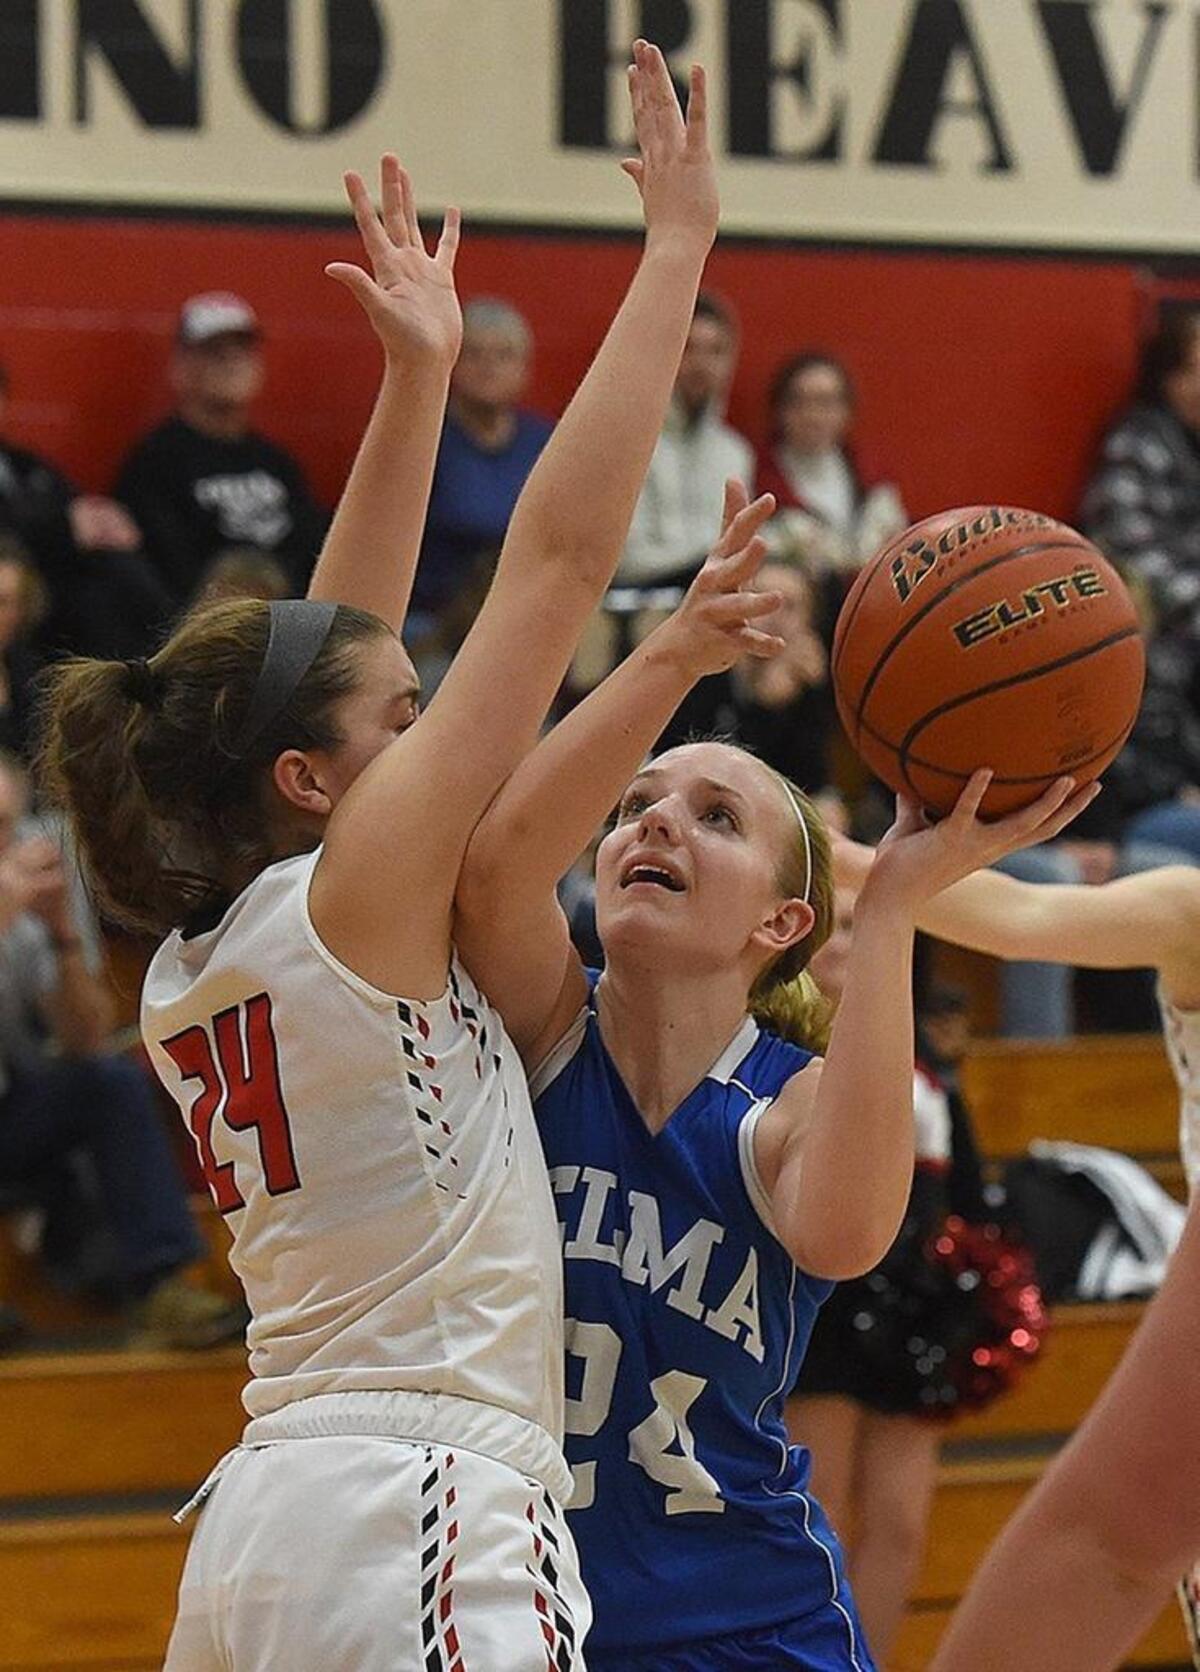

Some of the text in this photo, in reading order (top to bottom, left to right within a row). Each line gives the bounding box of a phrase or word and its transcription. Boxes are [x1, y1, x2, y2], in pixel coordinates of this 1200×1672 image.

[556, 0, 1200, 174] BEAV
[952, 571, 1108, 648] ELITE
[158, 991, 302, 1215] 24
[563, 1317, 726, 1516] 24
